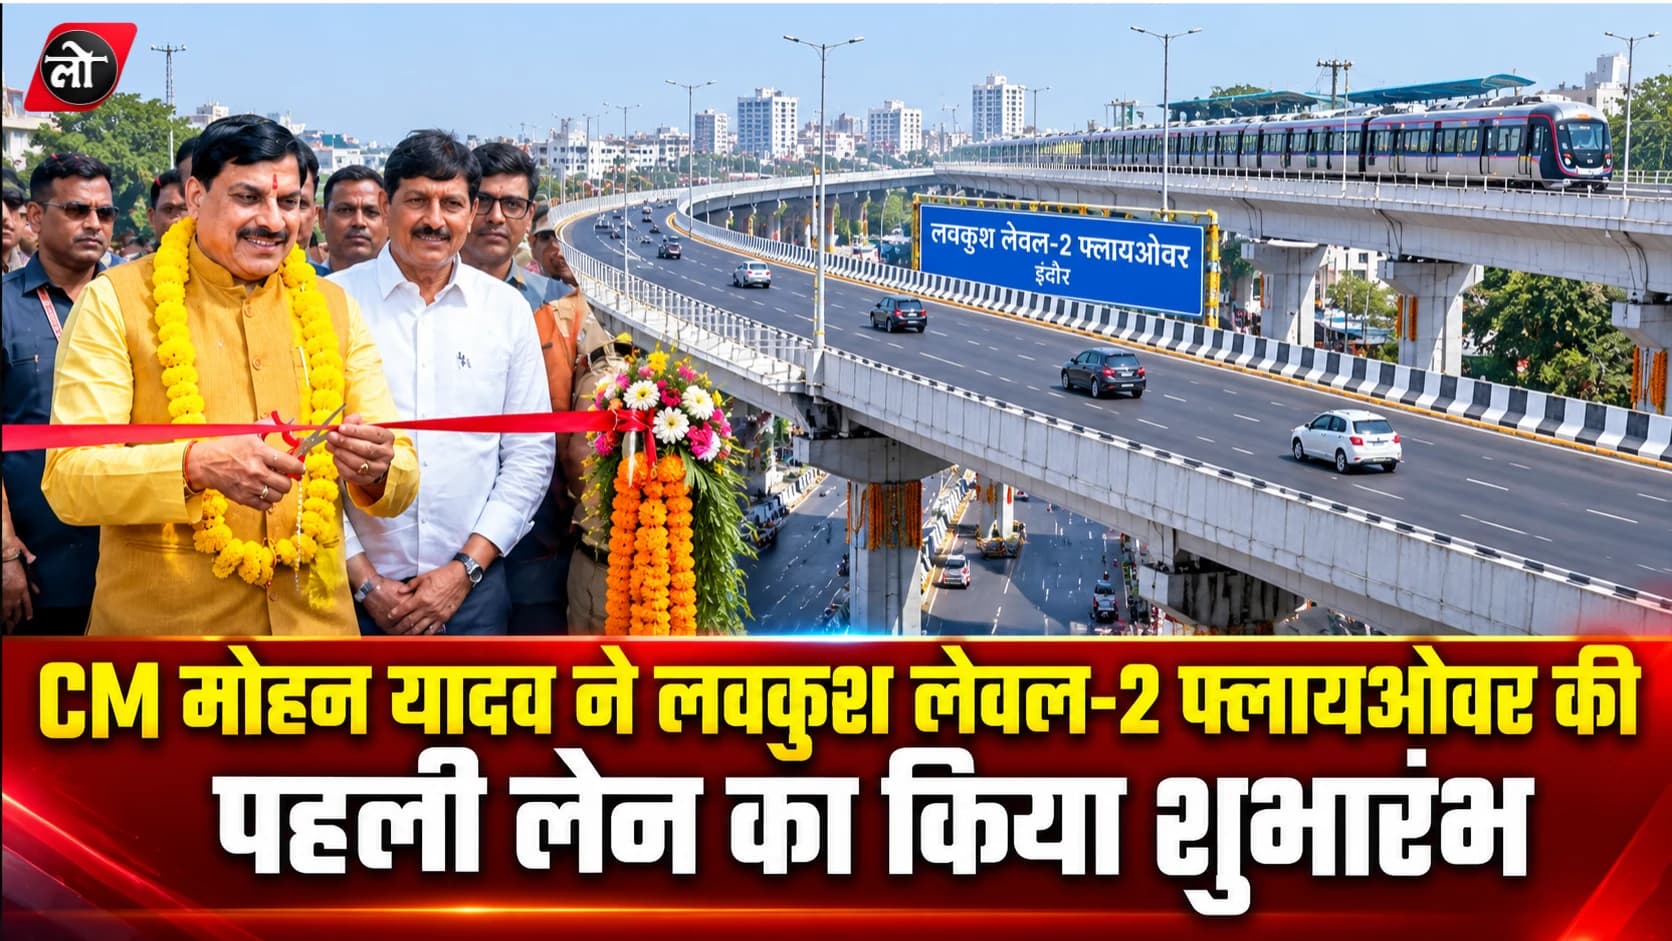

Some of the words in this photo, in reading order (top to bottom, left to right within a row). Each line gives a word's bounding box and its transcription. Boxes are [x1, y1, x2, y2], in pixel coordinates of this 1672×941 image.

[930, 222, 996, 255] लवकुश
[1000, 220, 1073, 257] लेवल-2
[1077, 232, 1191, 269] फ्लायओवर
[1034, 260, 1072, 287] इंदौर
